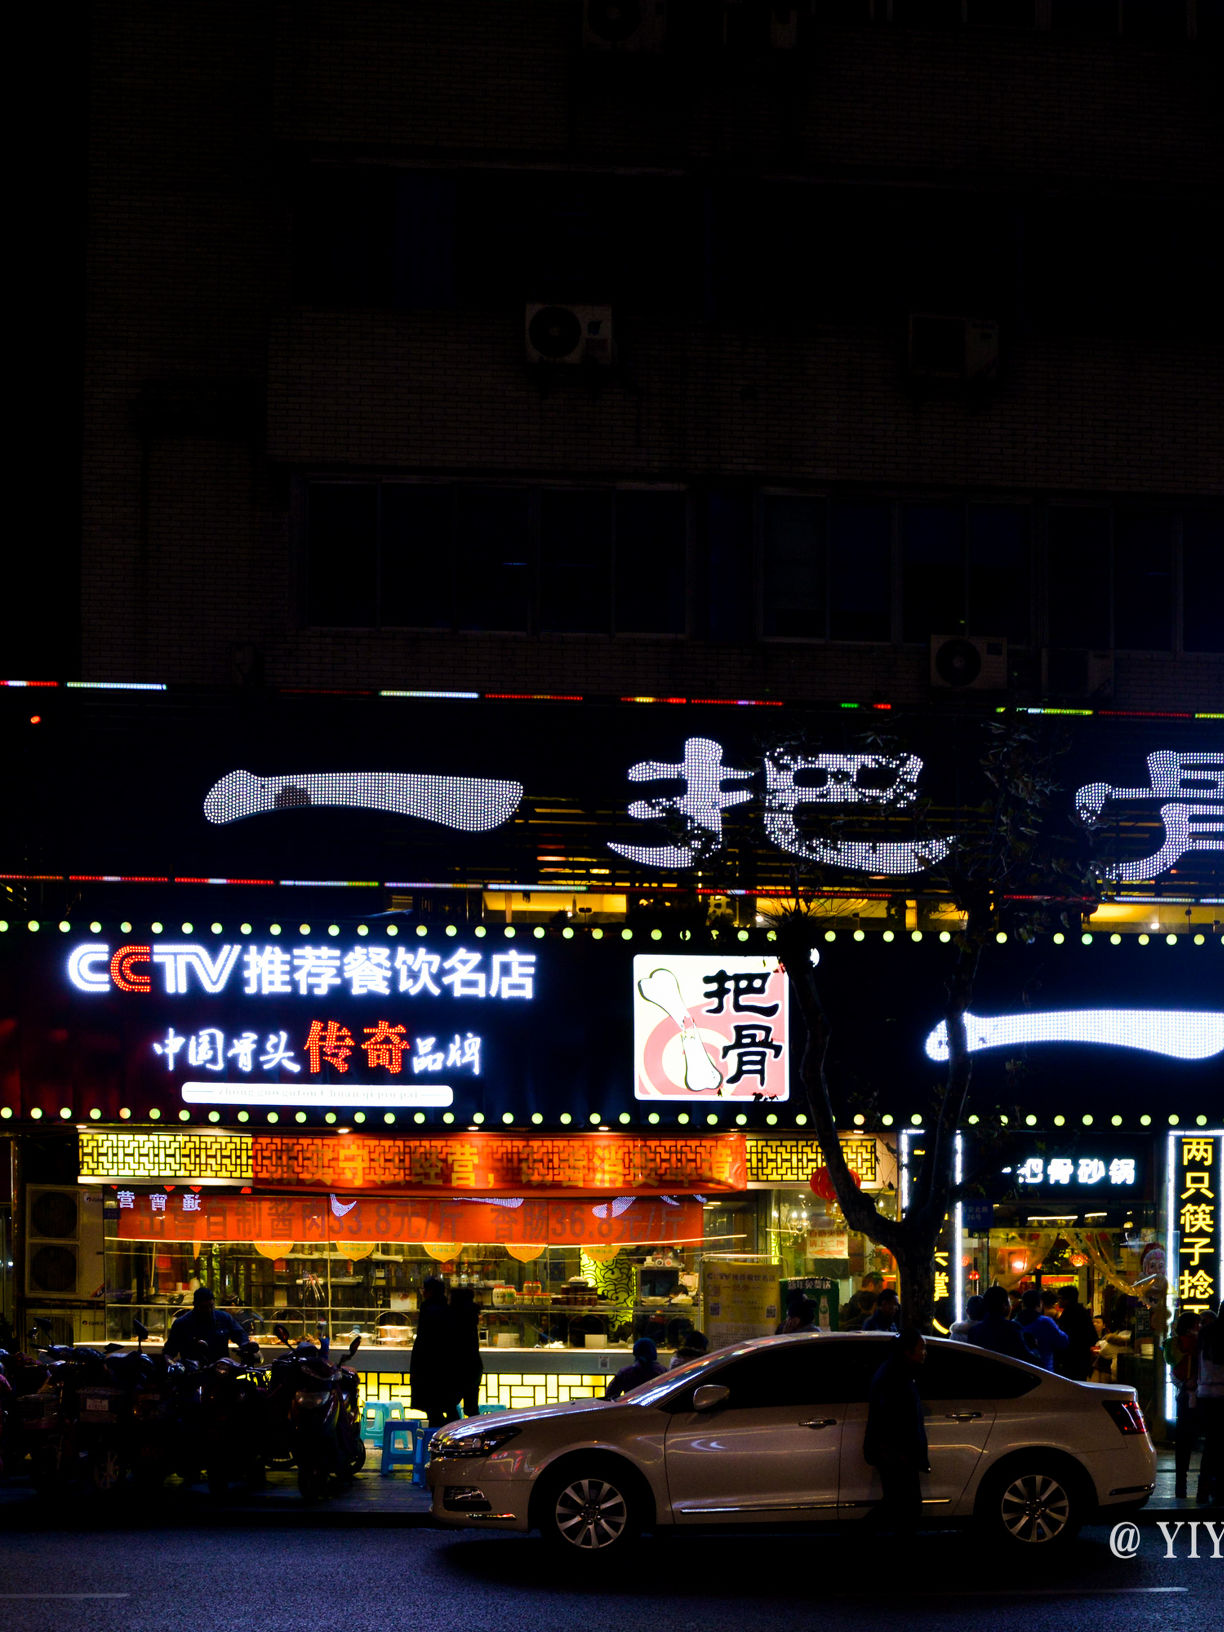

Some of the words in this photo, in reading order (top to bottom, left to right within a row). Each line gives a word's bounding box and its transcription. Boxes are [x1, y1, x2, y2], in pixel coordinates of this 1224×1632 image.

[67, 943, 538, 1001] CCTV推荐餐饮名店
[152, 1020, 483, 1076] 中国骨头传奇品牌
[1179, 1137, 1216, 1315] 两只筷子捻
